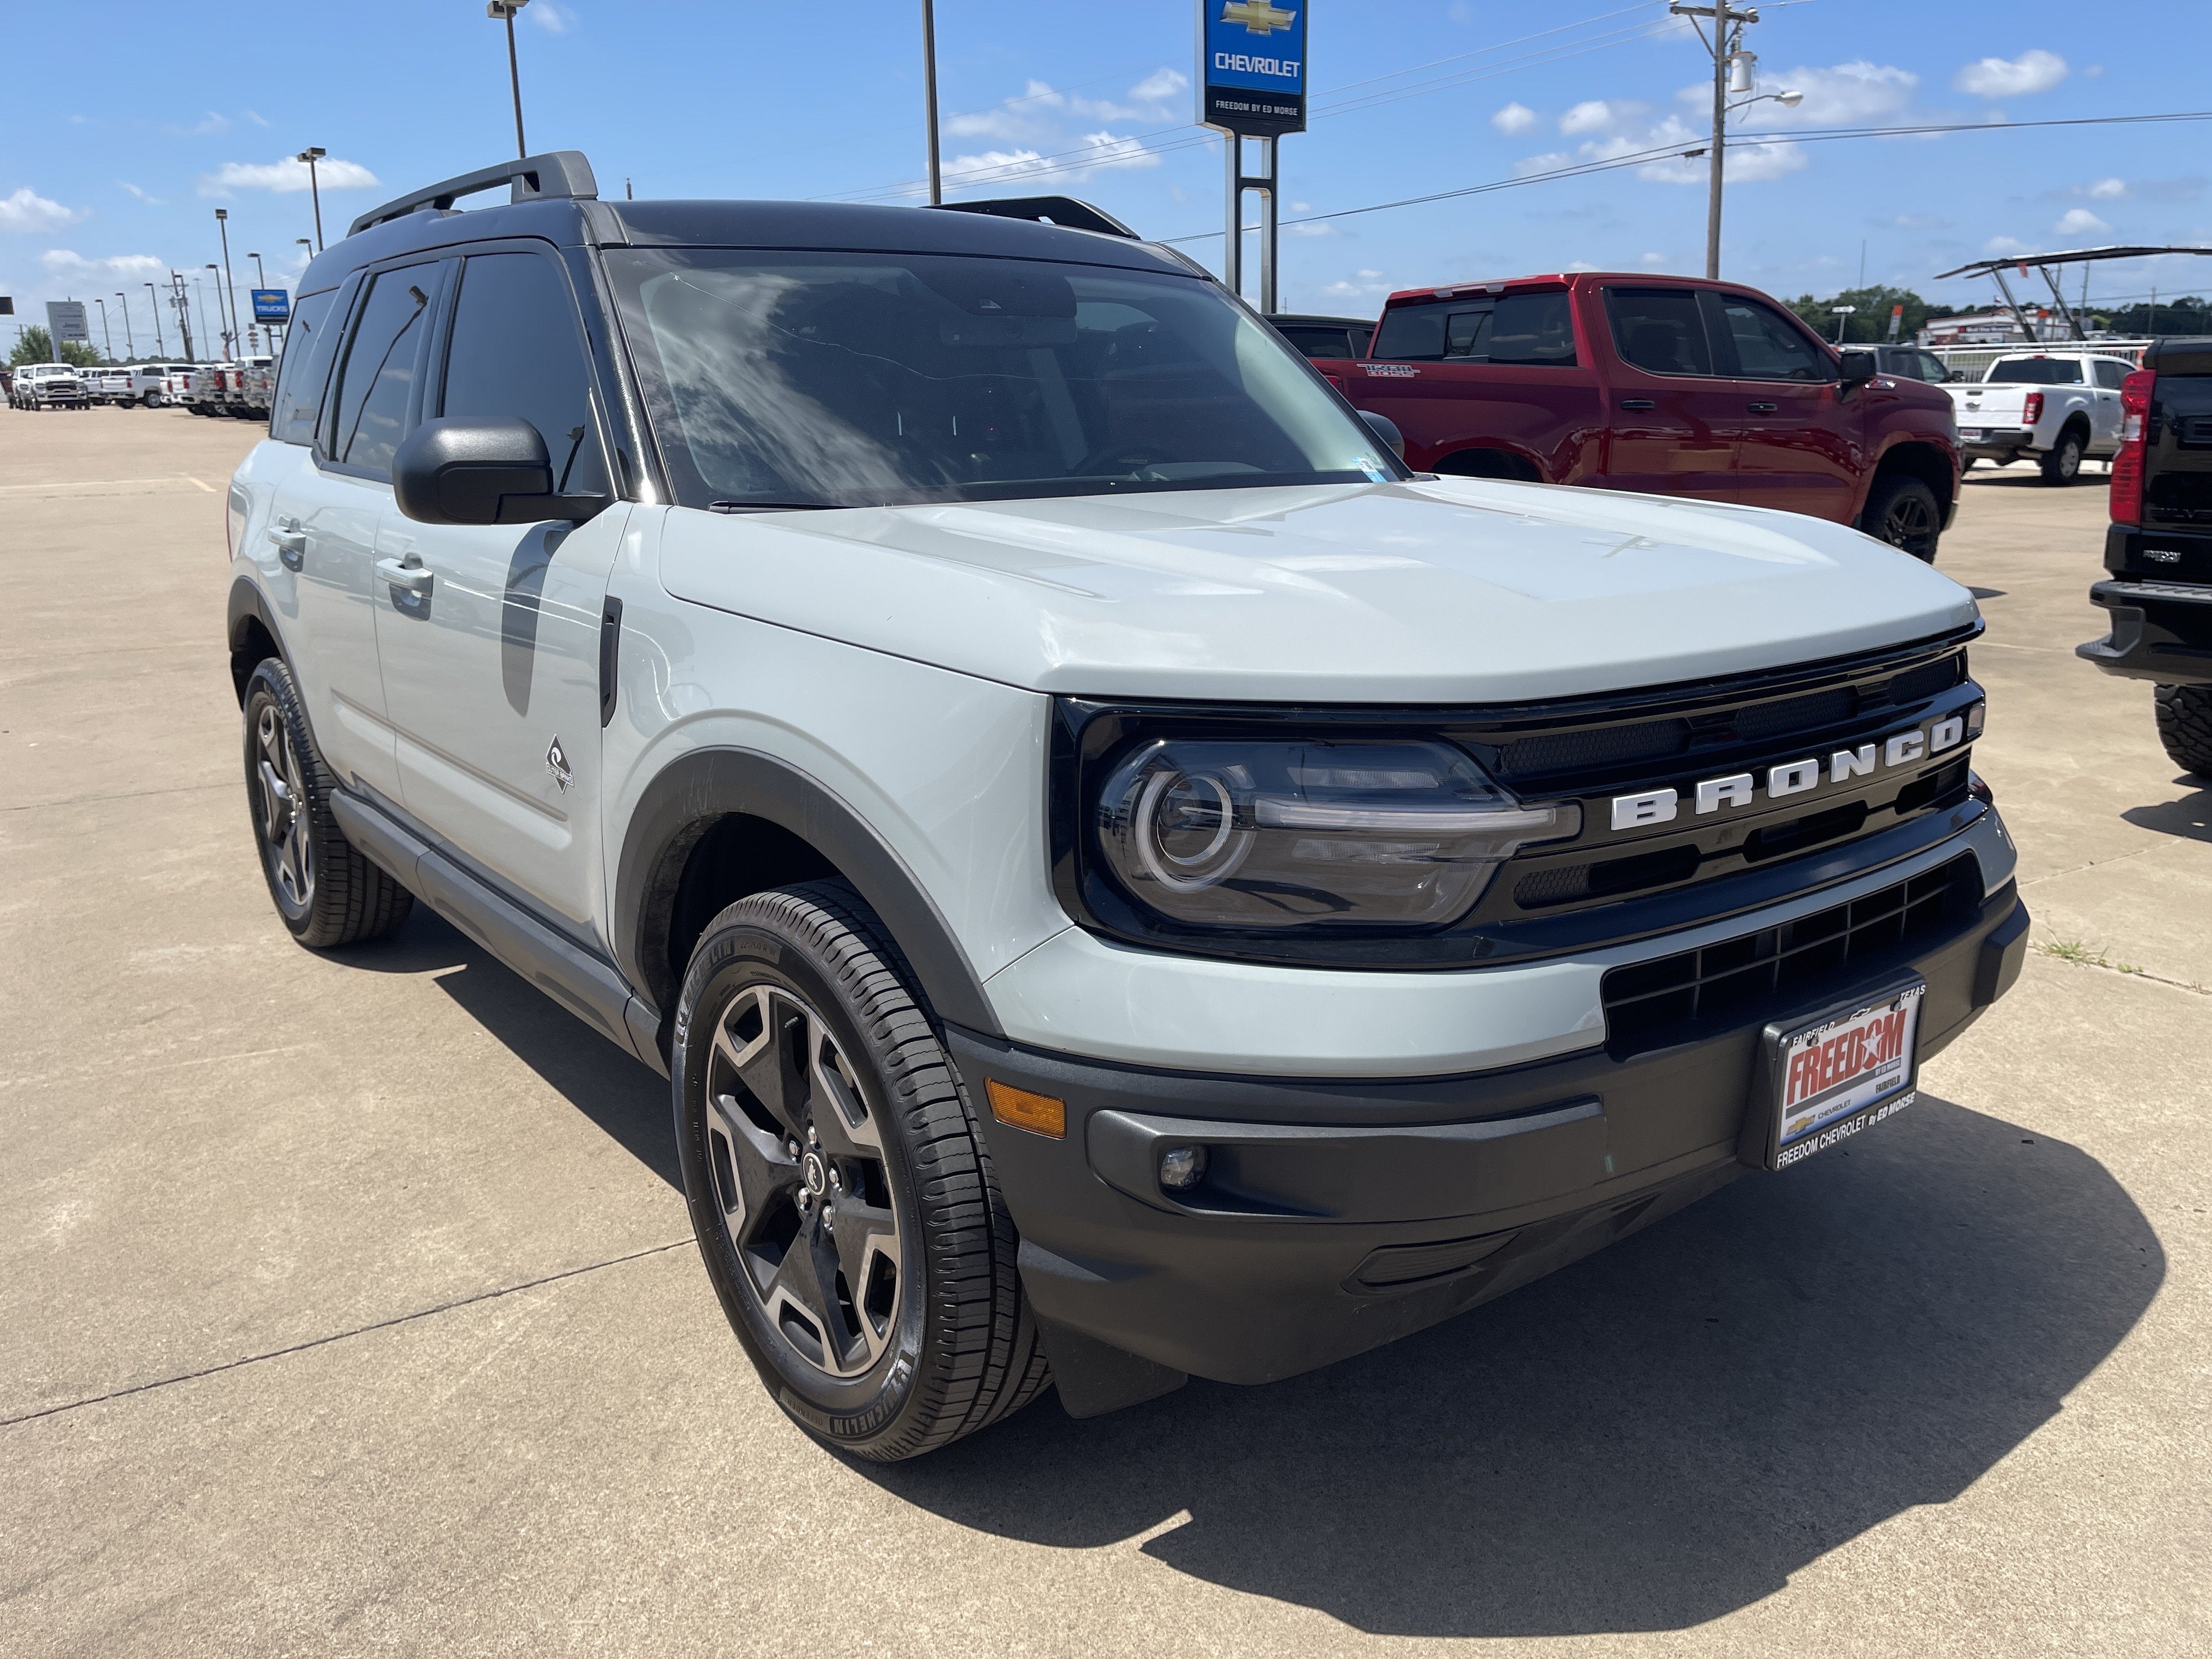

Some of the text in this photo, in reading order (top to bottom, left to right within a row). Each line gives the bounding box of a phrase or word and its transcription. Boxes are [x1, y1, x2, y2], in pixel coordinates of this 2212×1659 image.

[1215, 52, 1300, 77] CHEVROLET
[1216, 100, 1250, 111] FREEDOM
[1274, 106, 1298, 116] MORSE
[1357, 364, 1420, 373] TRAIL
[1611, 716, 1963, 831] BRONCO
[684, 939, 732, 1011] MICHELIN
[1792, 985, 1926, 1047] FAIRFIELD TEXAS
[1786, 1008, 1907, 1107] FREEDOM
[1876, 1075, 1900, 1094] FAIRFIELD
[1818, 1099, 1852, 1119] CHEVROLET
[1776, 1137, 1819, 1169] FREEDOM
[1819, 1114, 1866, 1149] CHEVROLET
[1877, 1105, 1888, 1122] ED
[1888, 1091, 1916, 1116] MORSE
[787, 1396, 823, 1426] DEFENDER
[833, 1388, 900, 1435] MICHELIN
